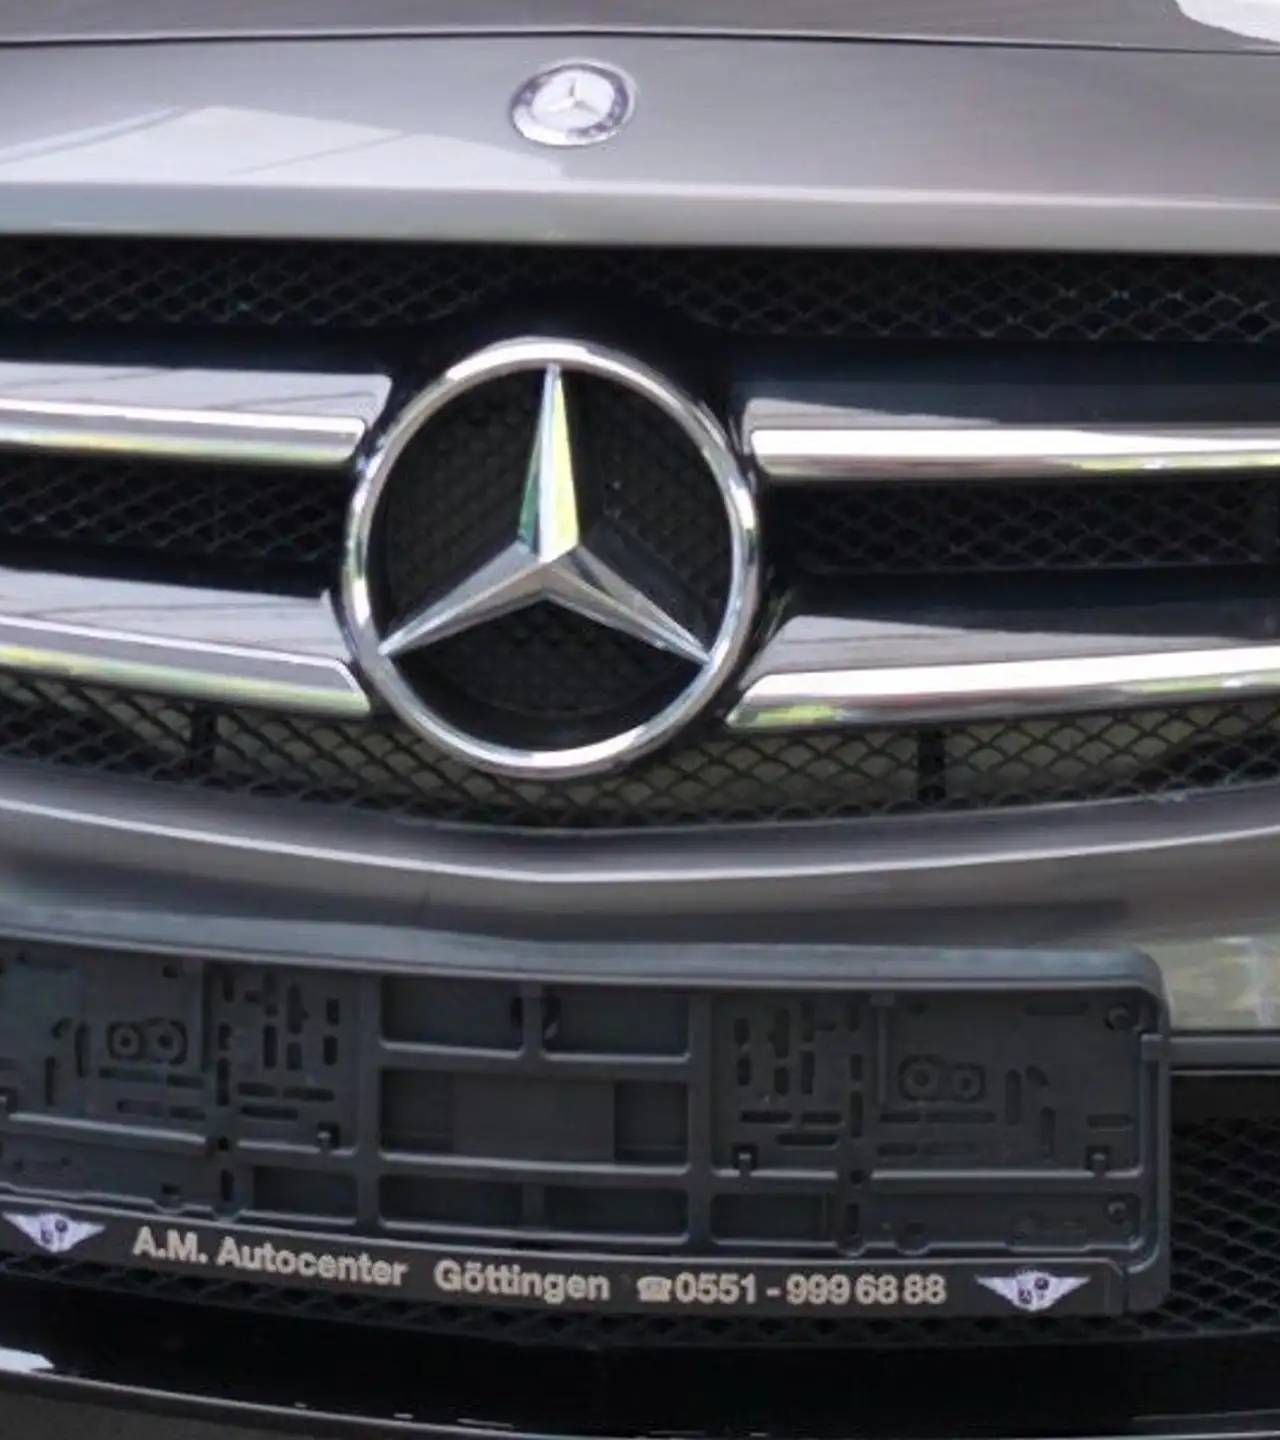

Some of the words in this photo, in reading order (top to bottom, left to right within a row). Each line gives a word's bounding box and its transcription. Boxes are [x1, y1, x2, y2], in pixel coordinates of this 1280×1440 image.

[132, 1225, 209, 1264] A.M.
[217, 1235, 409, 1287] Autocenter
[434, 1258, 611, 1303] Göttingen
[676, 1273, 756, 1303] 0551
